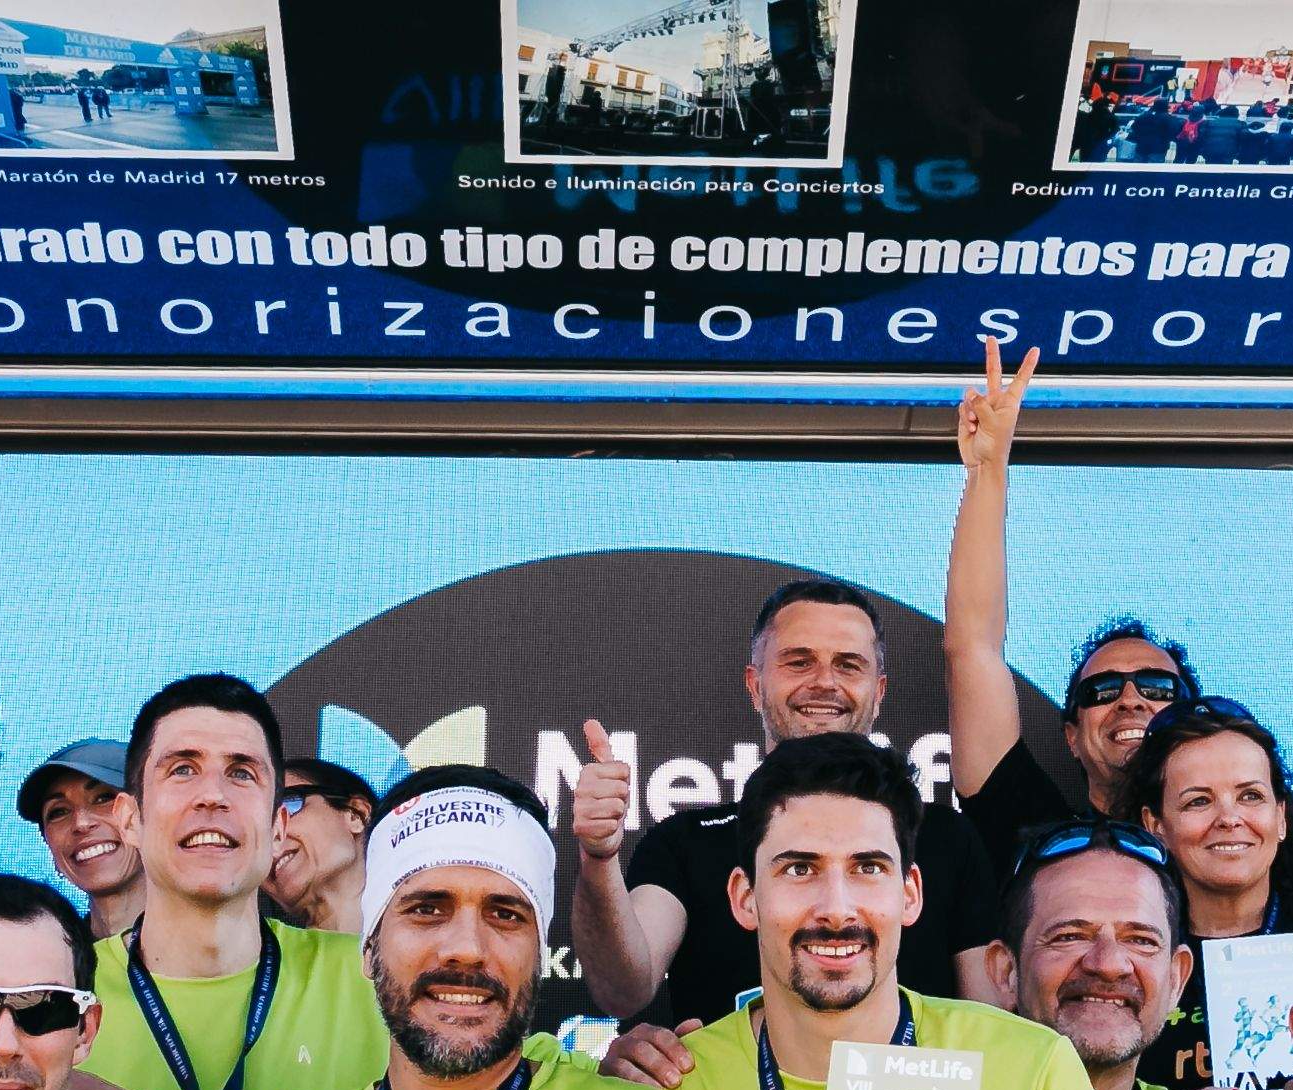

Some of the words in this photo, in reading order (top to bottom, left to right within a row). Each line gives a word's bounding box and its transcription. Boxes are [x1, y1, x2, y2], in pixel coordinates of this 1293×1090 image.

[88, 169, 115, 184] de
[124, 170, 205, 185] Madrid
[215, 172, 238, 185] 17
[248, 174, 326, 186] metros
[458, 175, 536, 189] Sonido
[545, 179, 558, 189] e
[567, 176, 696, 191] Iluminación
[705, 181, 754, 194] para
[763, 179, 885, 194] Conciertos
[1011, 182, 1094, 196] Podium
[1103, 183, 1117, 197] II
[1125, 186, 1165, 197] con
[1175, 184, 1261, 199] Pantalla
[157, 229, 275, 266] con
[285, 225, 427, 268] todo
[440, 226, 563, 273] tipo
[578, 228, 655, 271] de
[670, 231, 1137, 277] complementos
[1147, 242, 1291, 281] para
[390, 811, 487, 850] VALLECANA
[884, 1055, 974, 1081] MetLife
